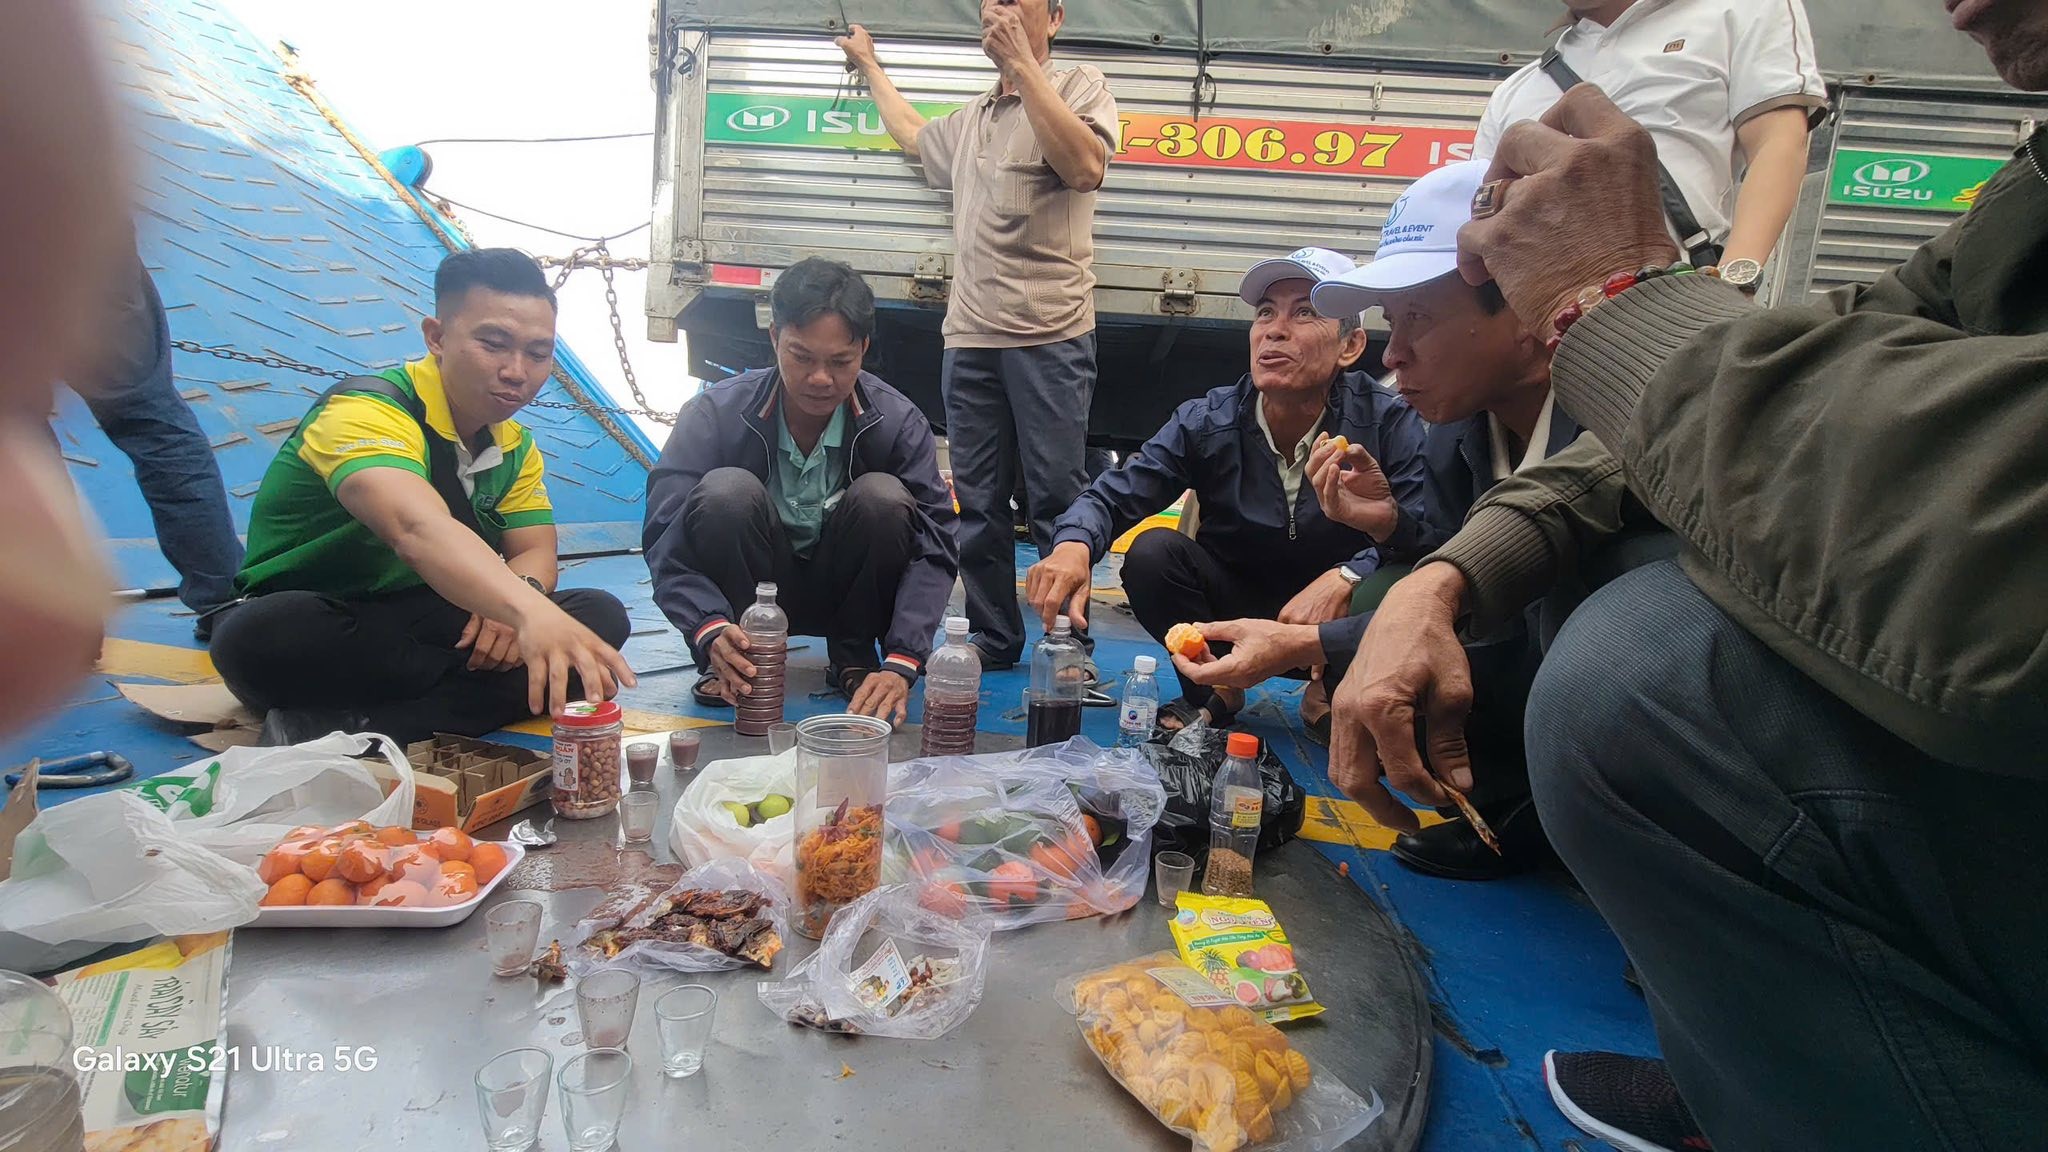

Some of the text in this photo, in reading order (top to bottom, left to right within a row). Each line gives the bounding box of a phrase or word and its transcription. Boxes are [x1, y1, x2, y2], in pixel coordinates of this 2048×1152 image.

[807, 109, 888, 135] ISU
[1843, 184, 1934, 201] ISUZU
[1408, 224, 1435, 233] EVENT
